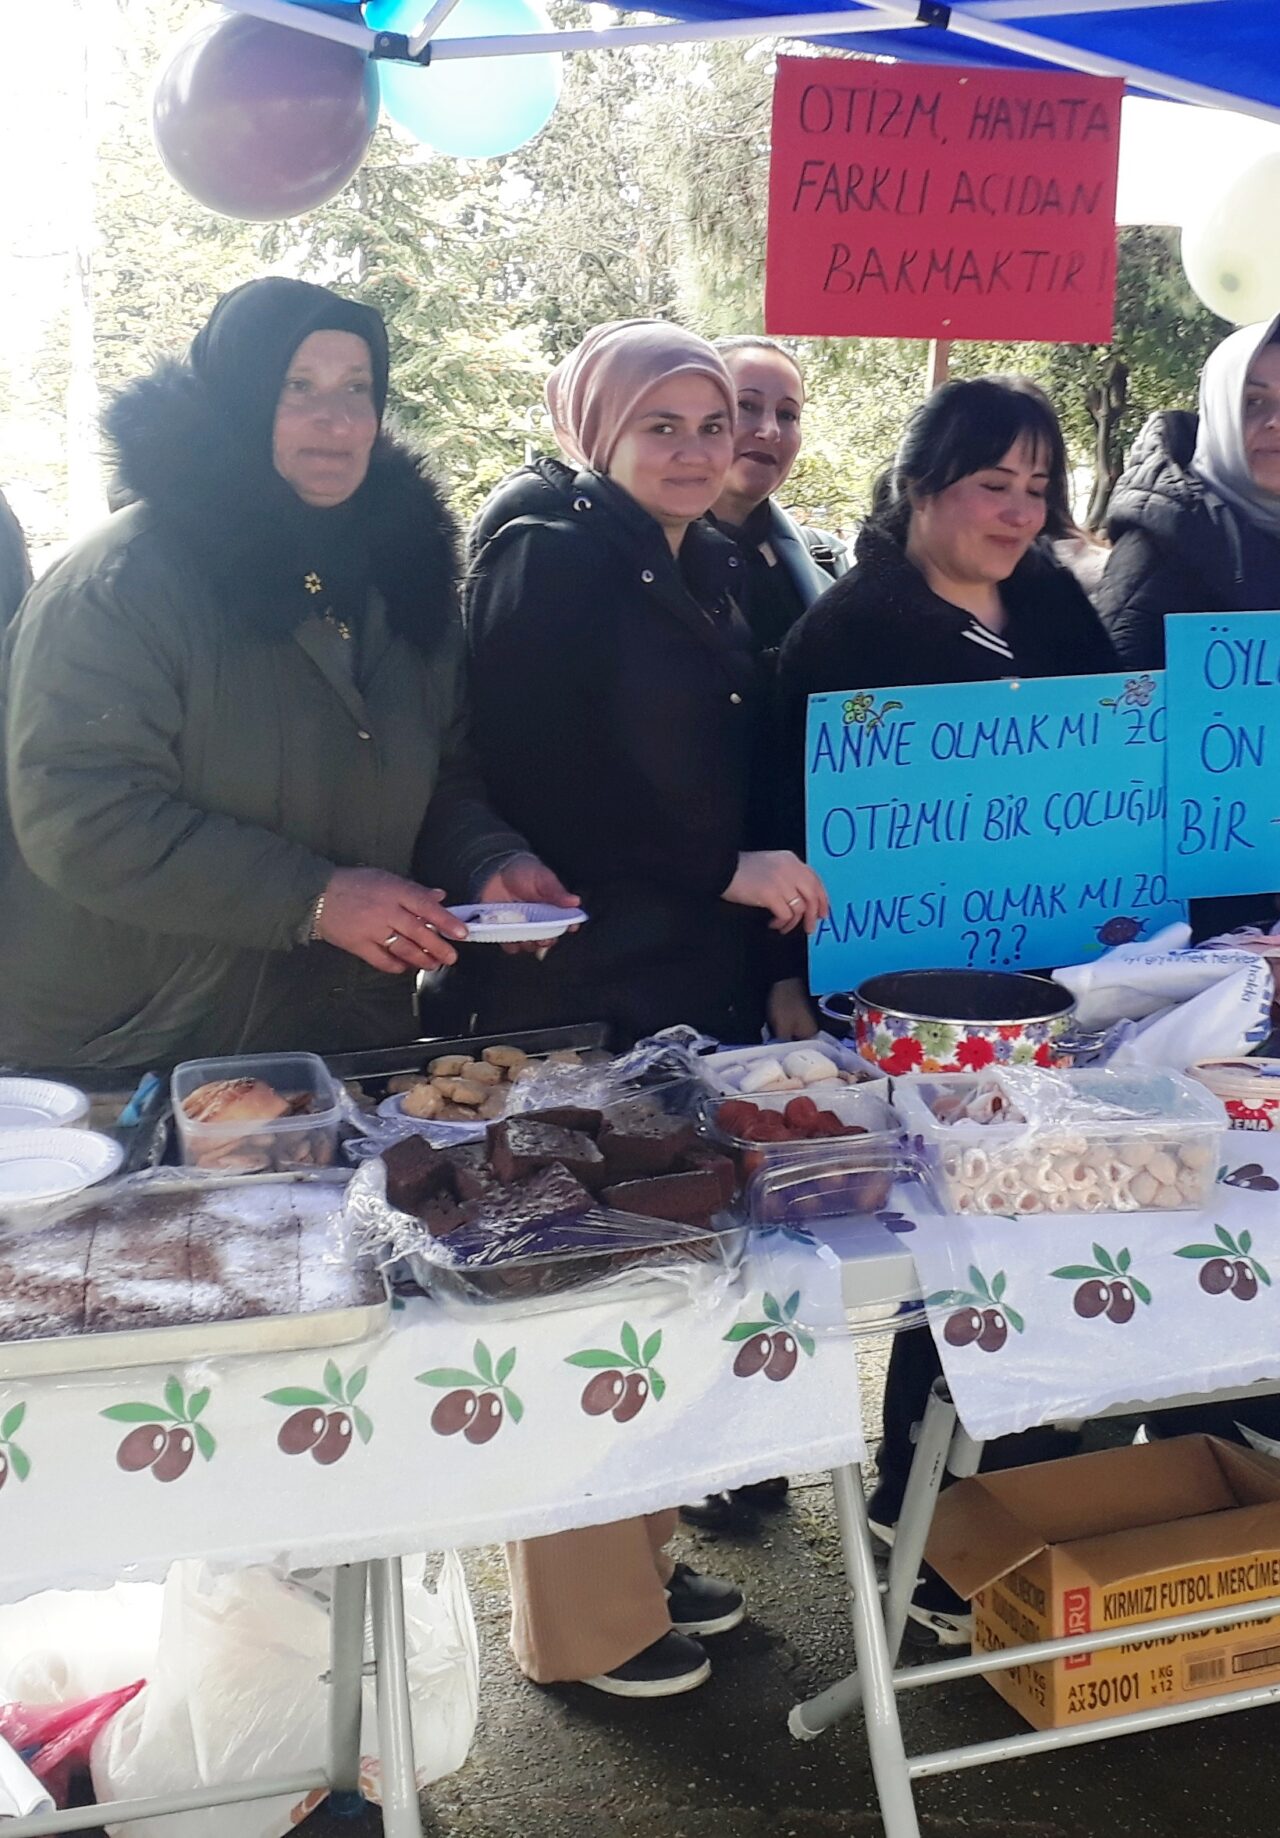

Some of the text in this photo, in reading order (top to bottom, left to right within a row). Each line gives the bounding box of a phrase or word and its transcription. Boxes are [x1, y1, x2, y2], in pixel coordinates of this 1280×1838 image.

[799, 81, 1113, 145] OTİZM, HAYATA
[793, 160, 1105, 217] FARKLI AÇIDAN
[811, 706, 1167, 774] ANNE OLMAK MI ZO
[1201, 710, 1266, 774] ÖN
[821, 779, 1168, 858] OTİZMLİ BİR ÇOCUĞU
[1176, 795, 1257, 856] BİR
[815, 873, 1187, 947] ANNESİ OLMAK MI ZO
[1103, 1586, 1158, 1622] KIRMIZI
[1160, 1573, 1214, 1610] FUTBOL
[1068, 1665, 1174, 1710] AT 30101 1 KG
[1068, 1699, 1087, 1715] AX
[1160, 1679, 1173, 1693] 12
